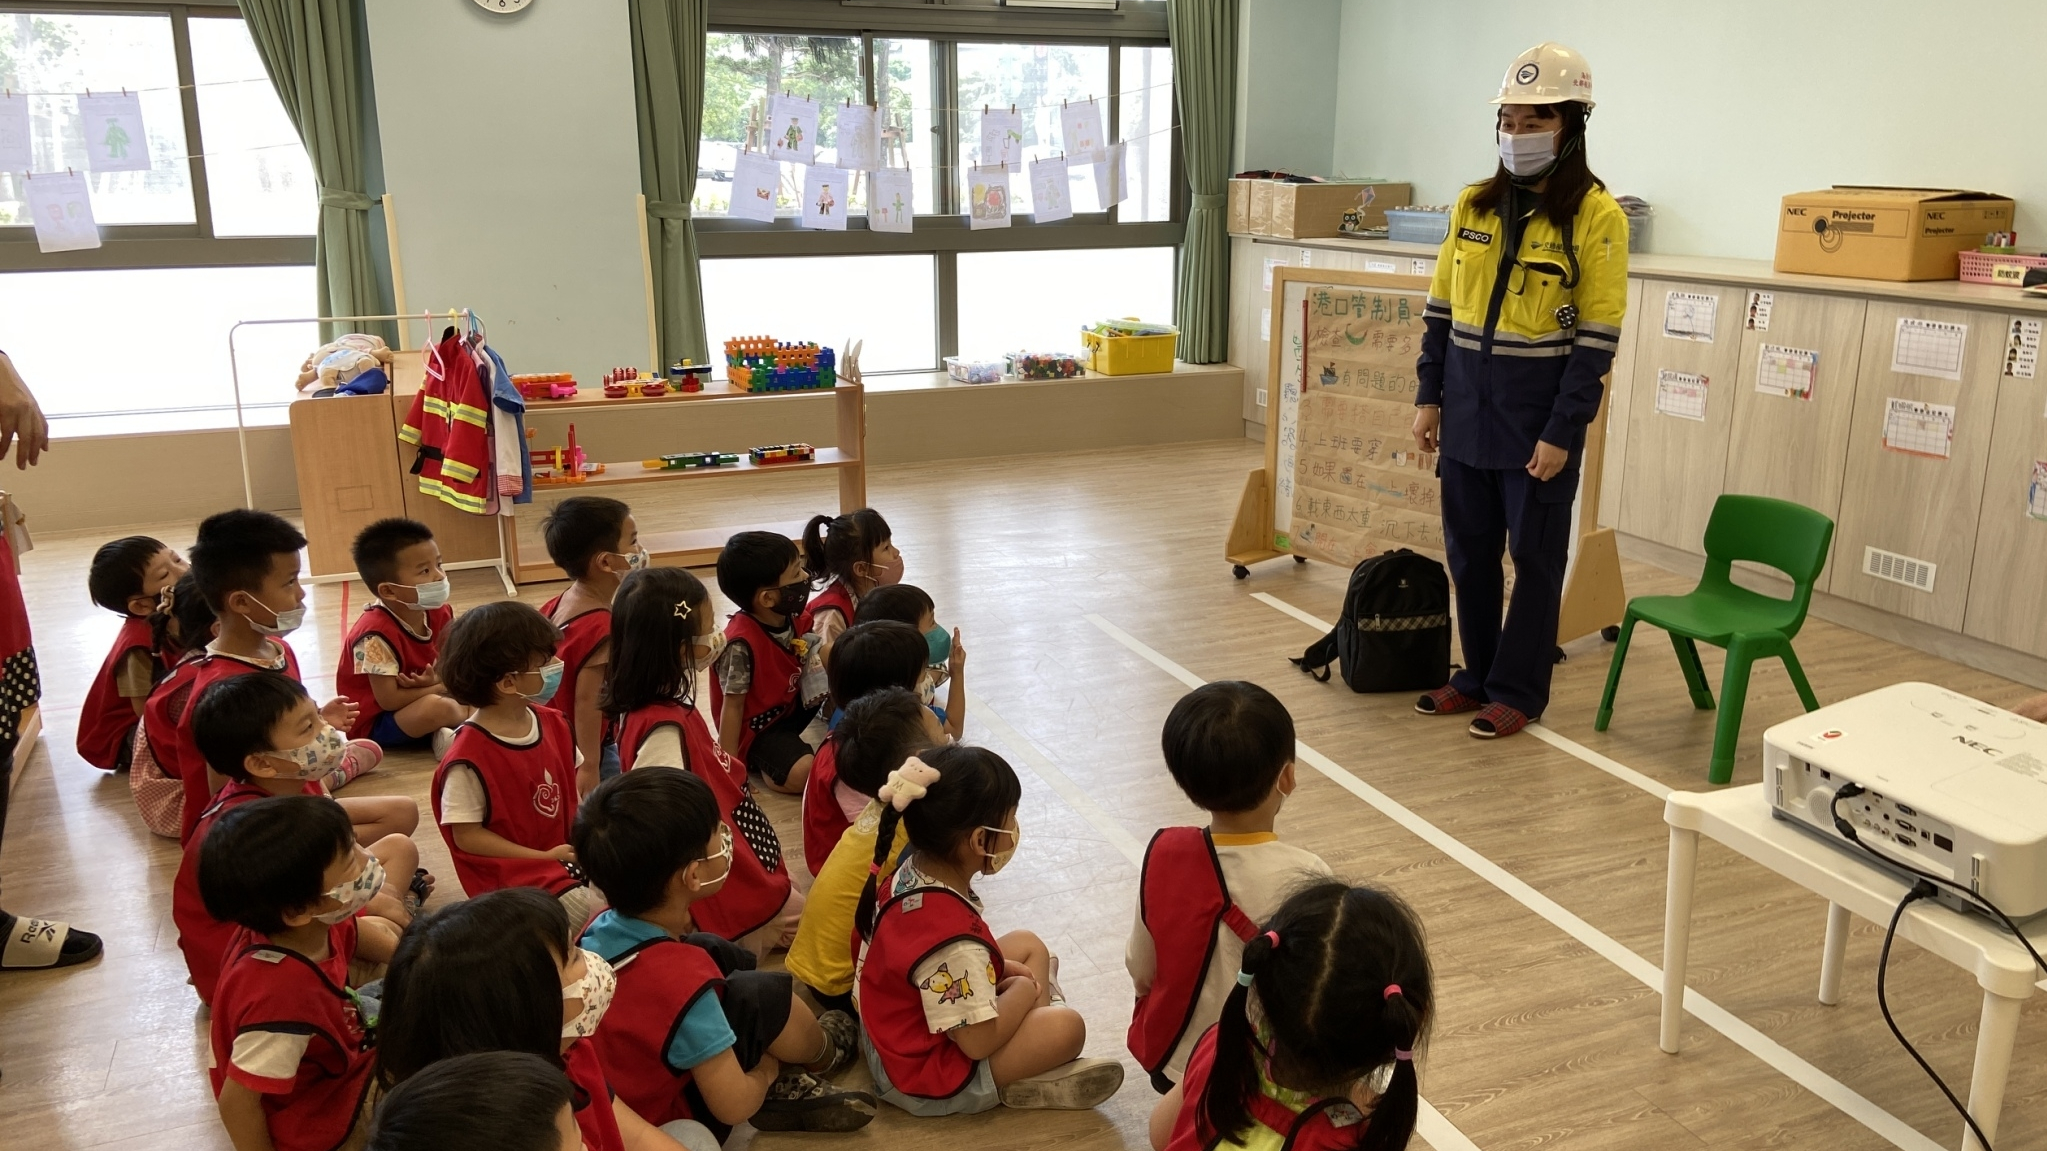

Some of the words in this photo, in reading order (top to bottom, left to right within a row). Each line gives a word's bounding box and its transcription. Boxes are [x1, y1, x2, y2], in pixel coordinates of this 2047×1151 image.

[1786, 207, 1807, 217] NEC
[1832, 210, 1876, 222] Projector
[1926, 212, 1946, 221] NEC
[1462, 229, 1489, 243] PSCO
[1924, 227, 1955, 235] Projector
[1371, 330, 1422, 356] 需要多
[1314, 431, 1382, 460] 上班要穿
[1299, 458, 1308, 474] 5
[1312, 461, 1336, 483] 如果
[1387, 480, 1438, 507] 上壞掉
[1295, 496, 1302, 511] 6
[1353, 541, 1385, 560] 上會
[1952, 734, 2004, 757] NEC
